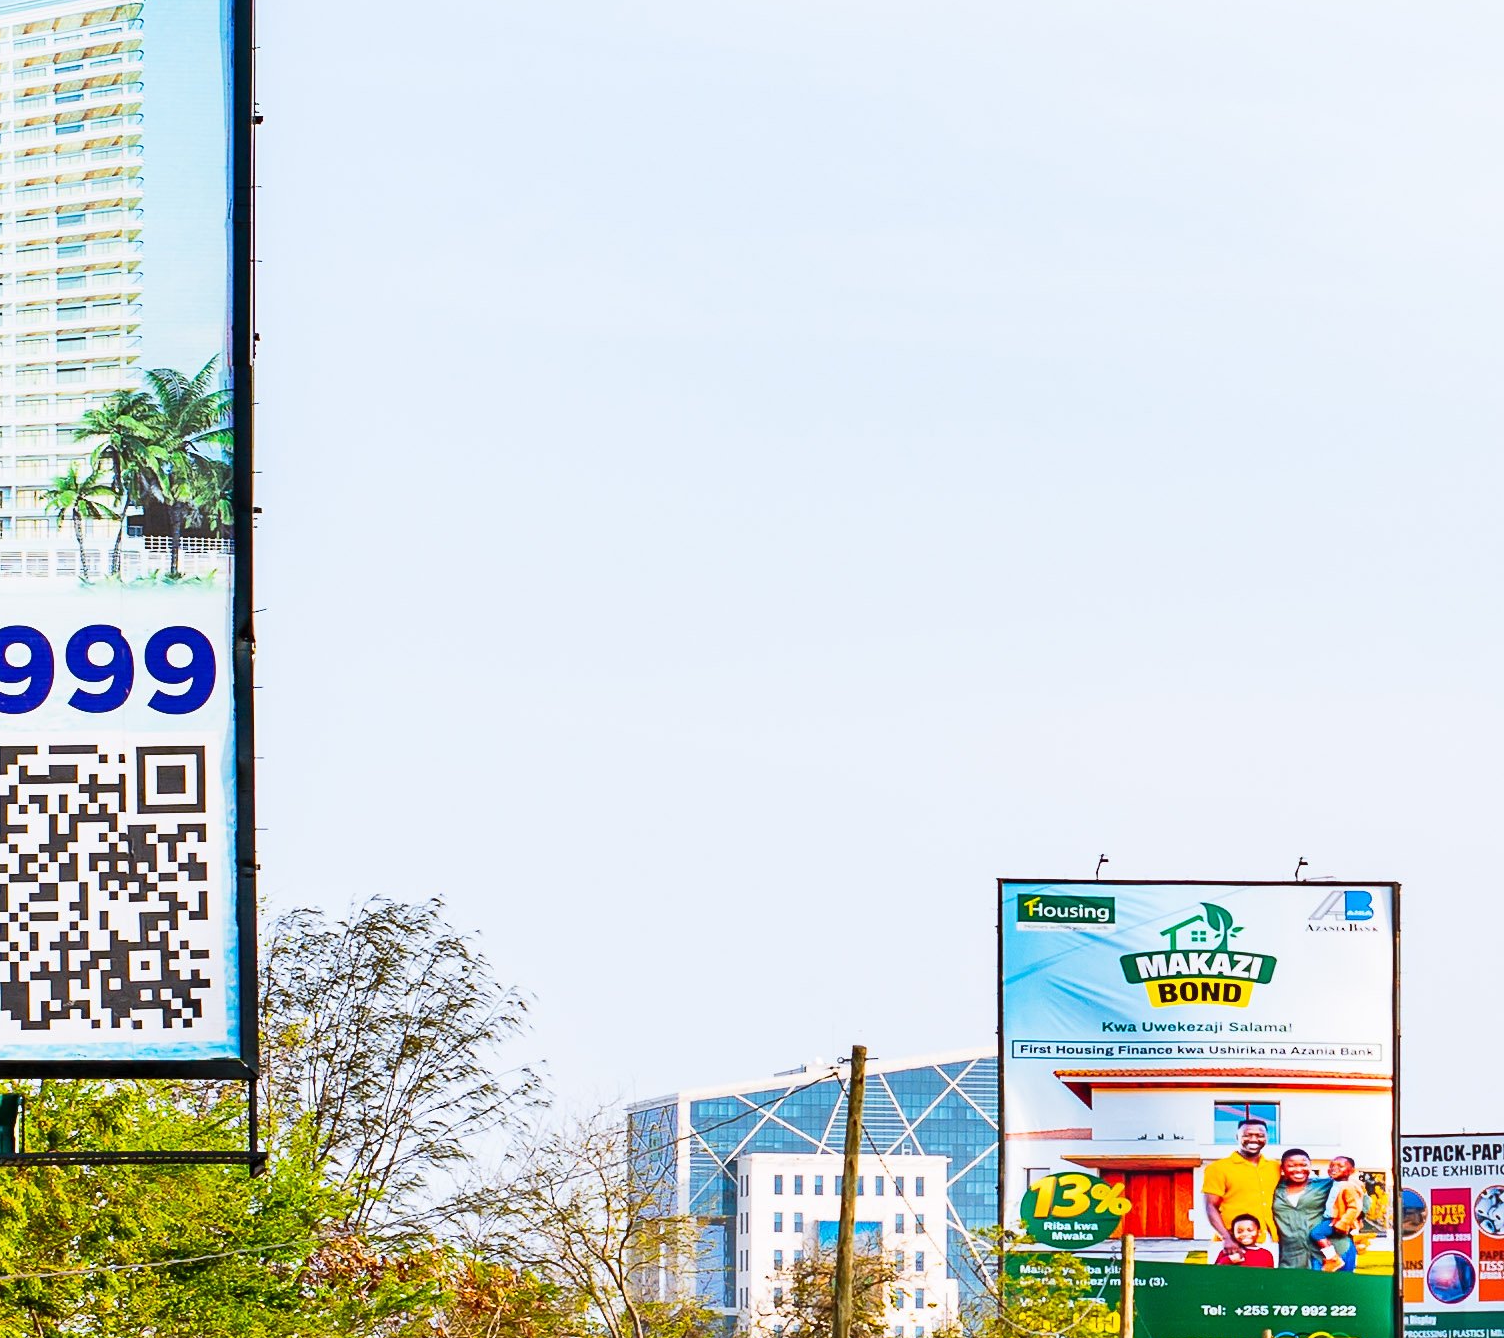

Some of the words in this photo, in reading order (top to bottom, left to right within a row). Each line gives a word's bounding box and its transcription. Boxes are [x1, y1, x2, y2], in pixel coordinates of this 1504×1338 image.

[1135, 952, 1263, 980] MAKAZI
[1157, 981, 1242, 1004] BOND
[1102, 1021, 1137, 1033] Kwa
[1142, 1021, 1223, 1035] Uwekezaji
[1229, 1022, 1292, 1033] Salama!
[1020, 1044, 1051, 1055] First
[1056, 1044, 1114, 1057] Housing
[1118, 1045, 1173, 1056] Finance
[1177, 1045, 1204, 1056] kwa
[1209, 1045, 1265, 1056] Ushirika
[1270, 1048, 1287, 1056] na
[1291, 1046, 1335, 1056] Azania
[1341, 1046, 1373, 1057] Bank
[1402, 1166, 1439, 1177] RADE
[1030, 1173, 1133, 1219] 13%
[1432, 1204, 1465, 1214] INTER
[1432, 1214, 1466, 1225] PLAST
[1044, 1221, 1072, 1231] Riba
[1074, 1221, 1099, 1231] kwa
[1051, 1232, 1094, 1241] Mwaka
[1149, 1277, 1168, 1287] (3).
[1201, 1305, 1227, 1316] Tel:
[1234, 1305, 1269, 1316] +255
[1330, 1305, 1357, 1317] 222
[1452, 1329, 1485, 1338] PLASTICS
